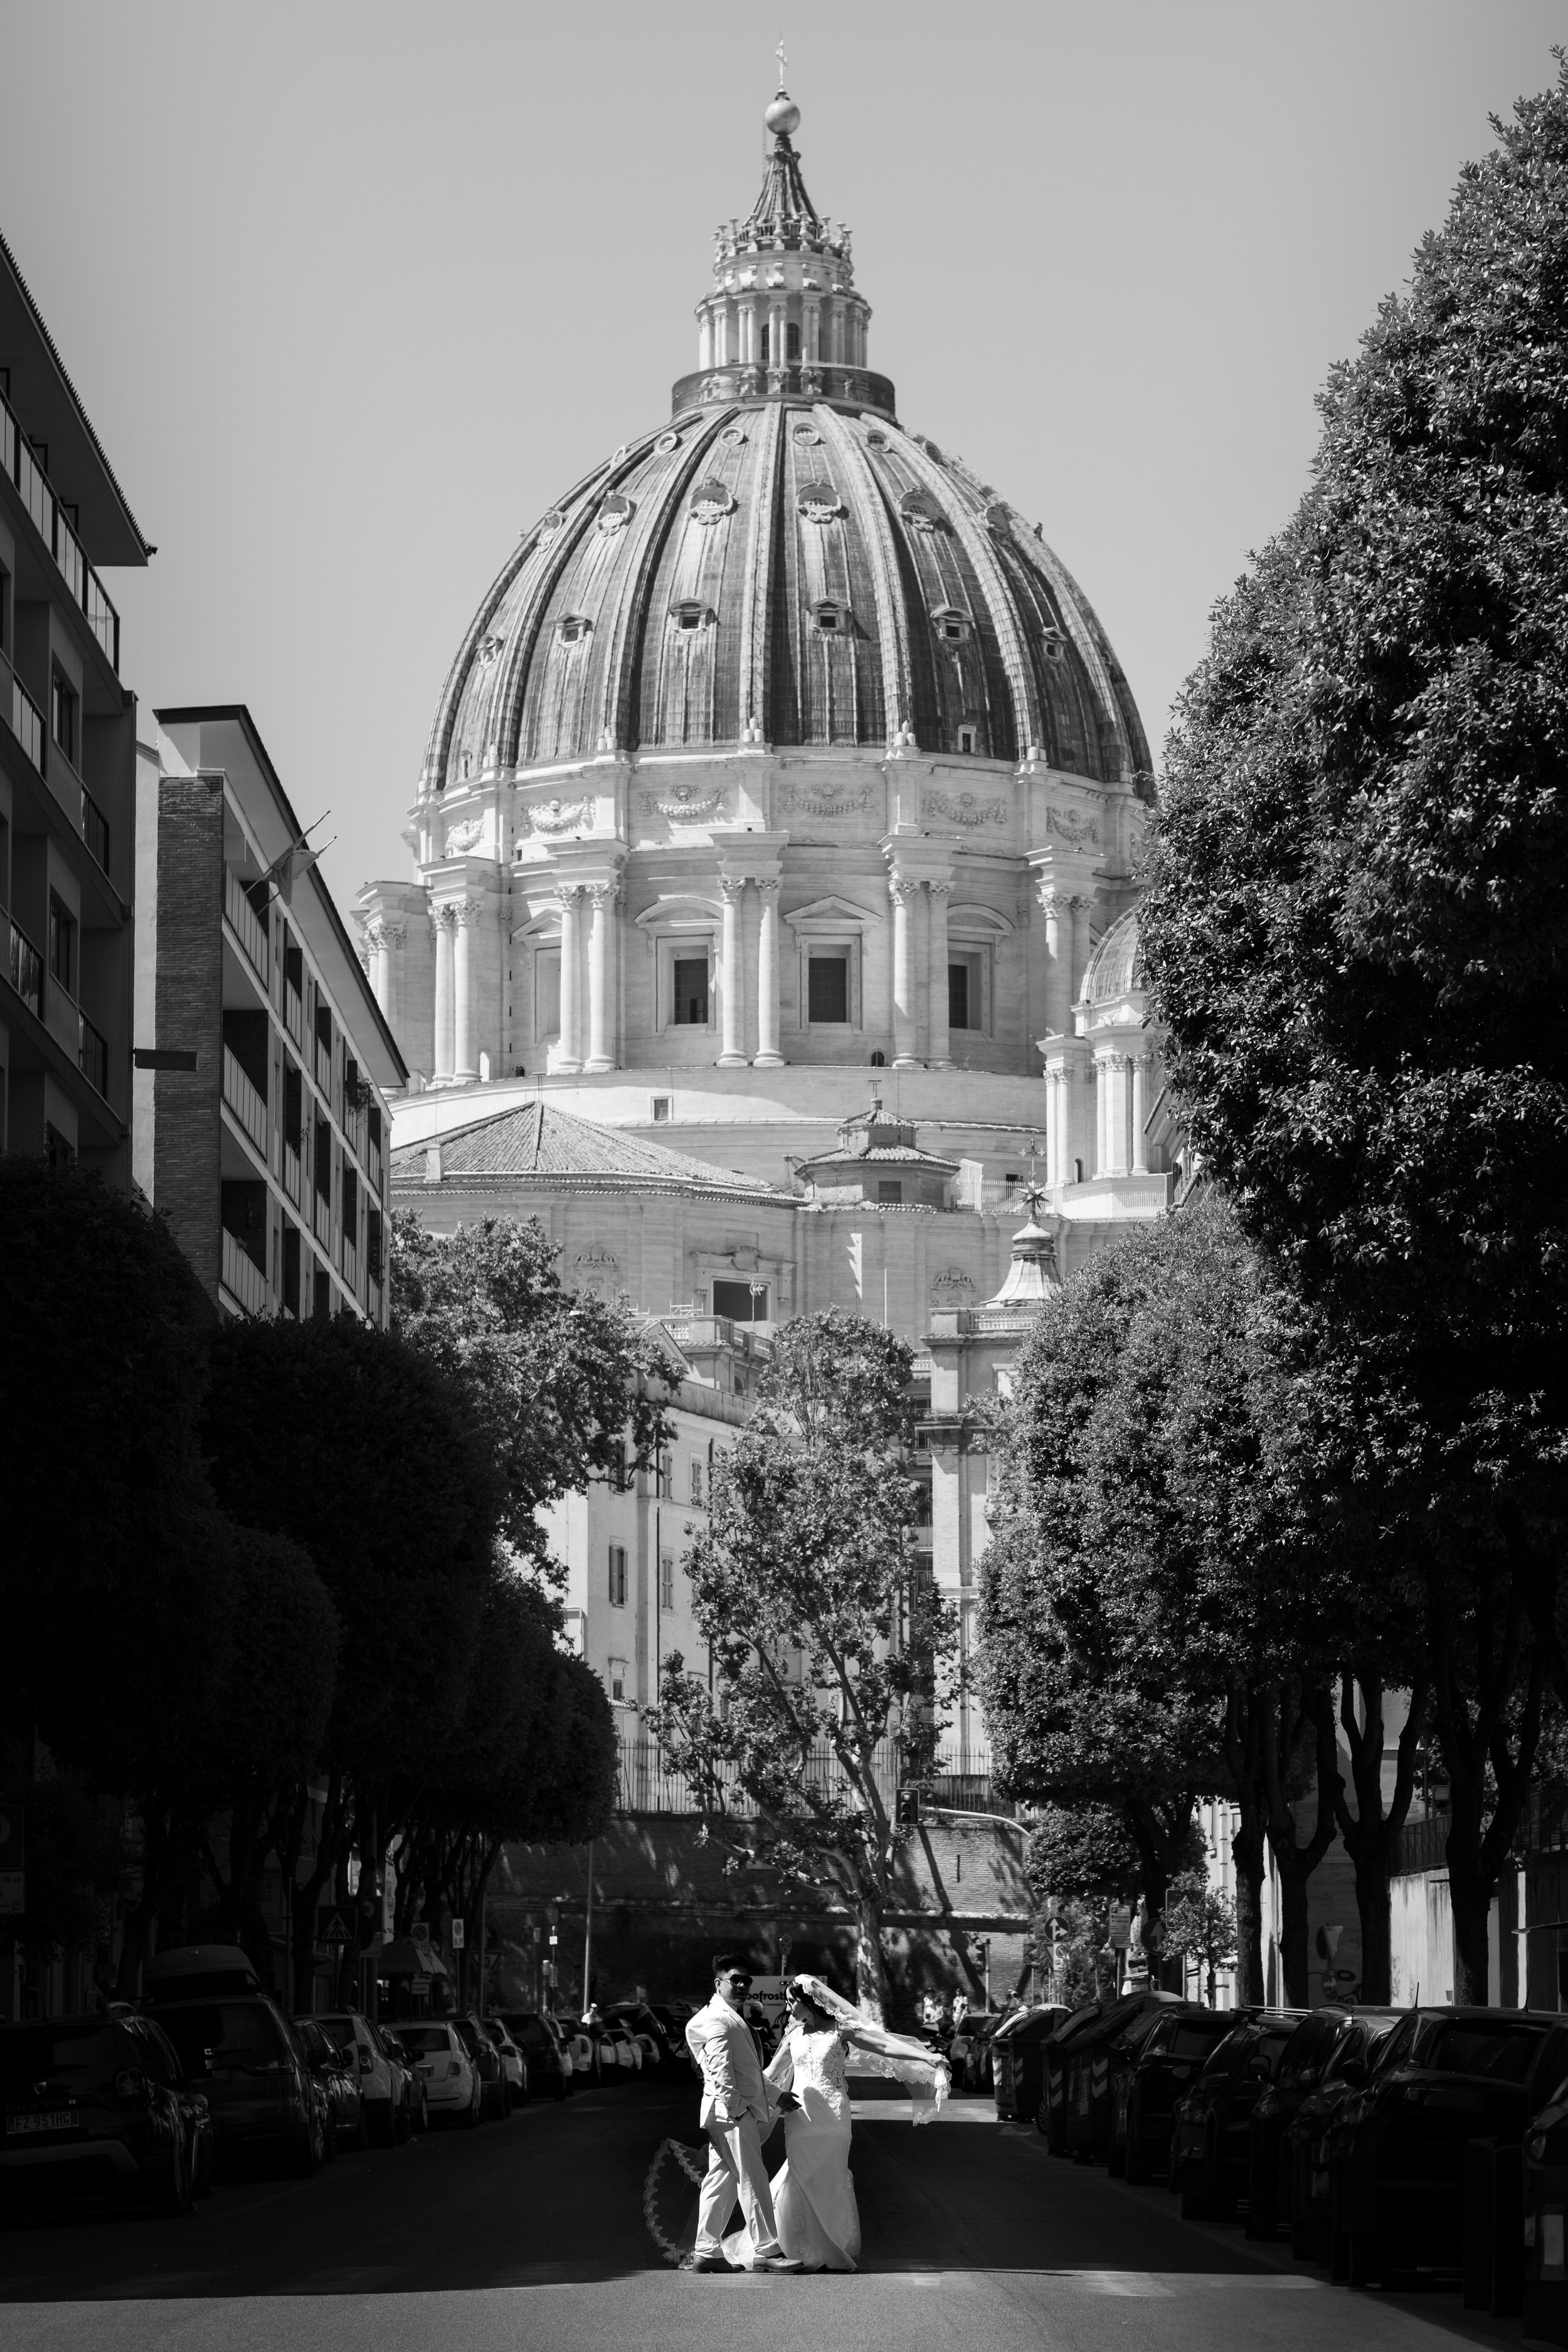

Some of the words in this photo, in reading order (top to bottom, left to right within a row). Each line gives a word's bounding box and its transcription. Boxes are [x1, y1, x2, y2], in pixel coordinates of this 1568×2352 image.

[5, 2099, 77, 2112] DUSTER
[16, 2117, 29, 2129] FZ
[34, 2113, 70, 2127] 951HG
